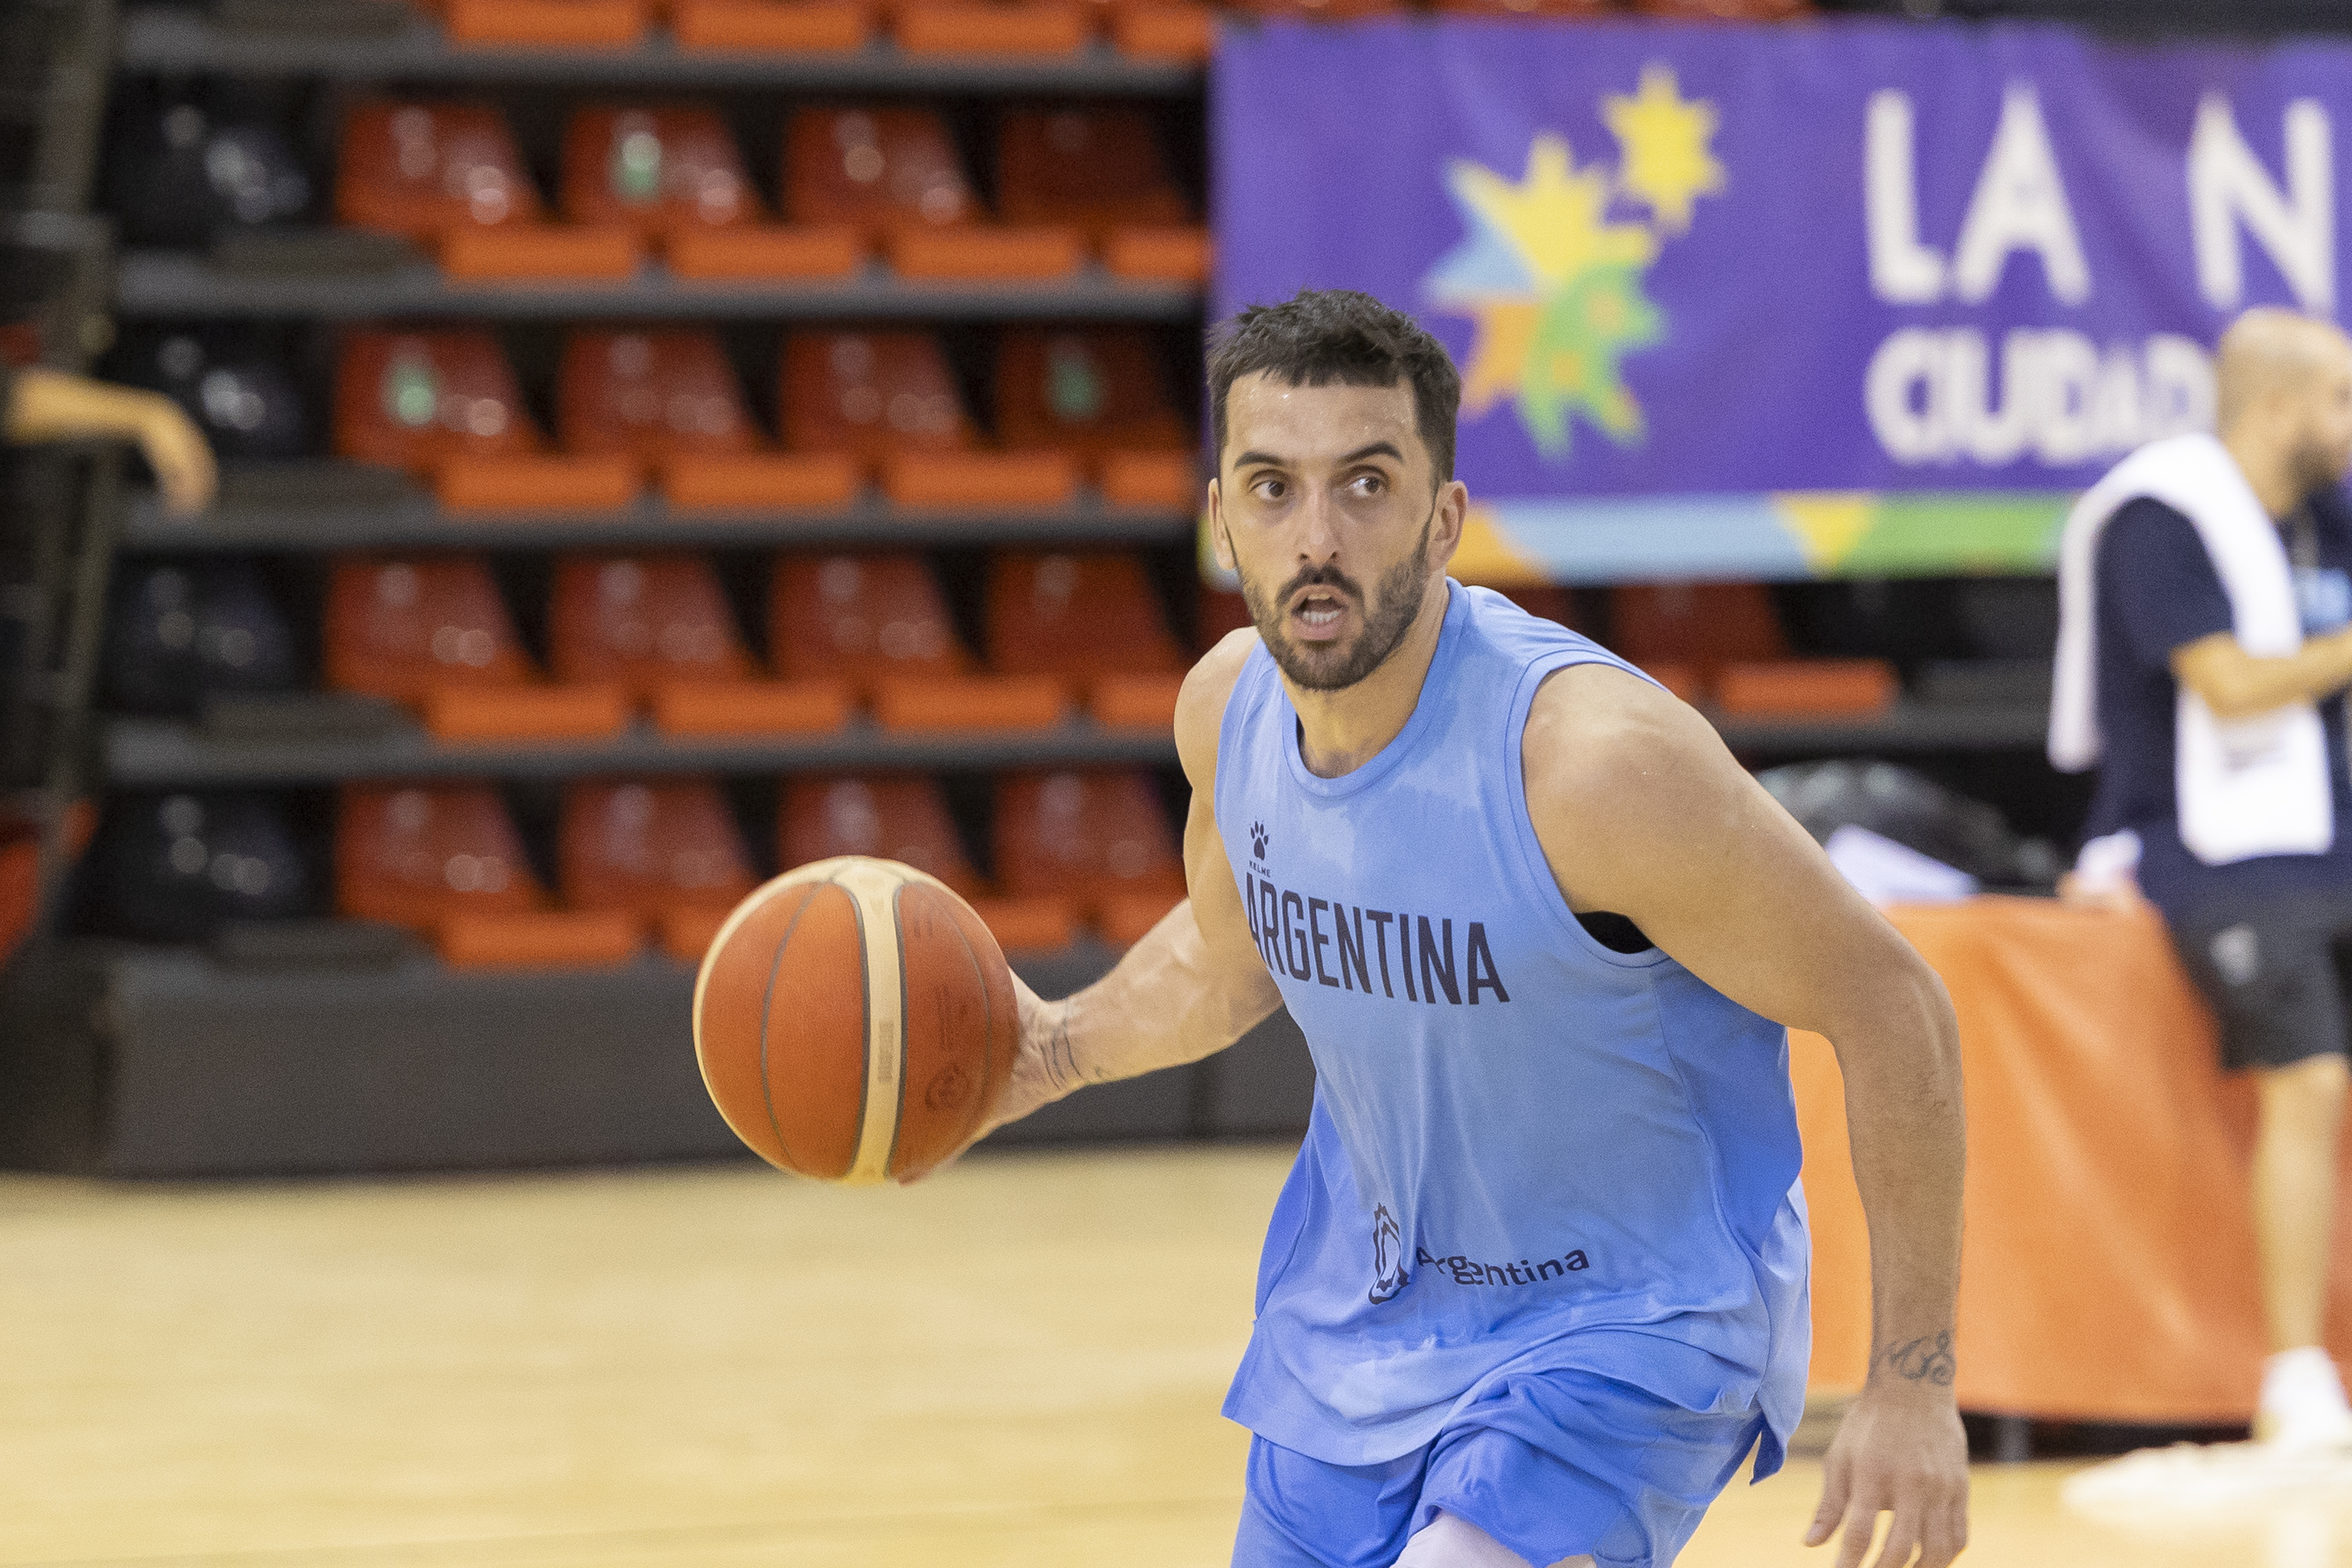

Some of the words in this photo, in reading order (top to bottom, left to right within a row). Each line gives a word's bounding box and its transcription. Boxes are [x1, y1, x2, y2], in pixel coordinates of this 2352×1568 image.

[1865, 82, 2090, 303] LA
[1249, 860, 1271, 877] KELME
[1246, 872, 1511, 1005] ARGENTINA
[1416, 1246, 1590, 1286] Argentina
